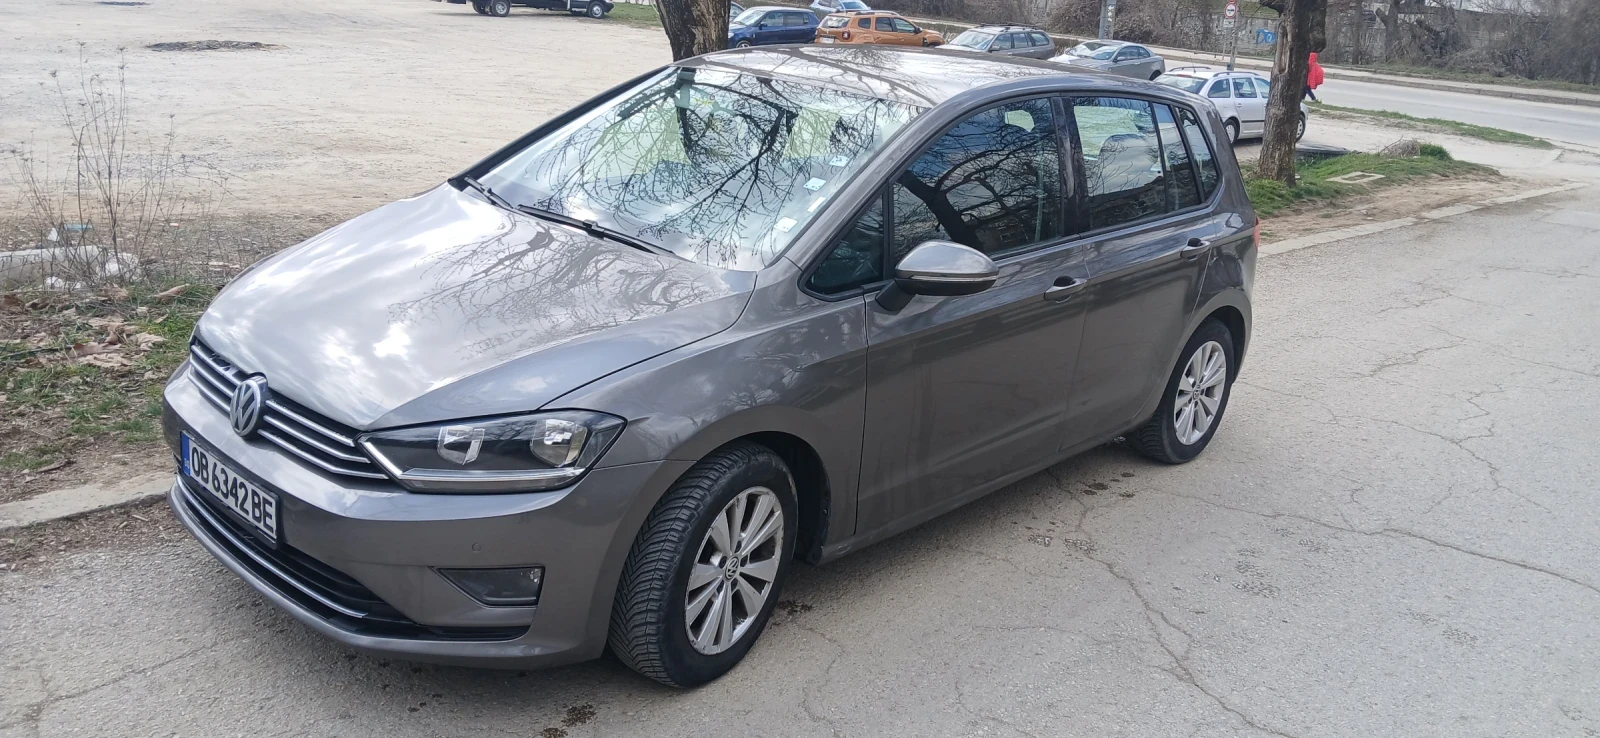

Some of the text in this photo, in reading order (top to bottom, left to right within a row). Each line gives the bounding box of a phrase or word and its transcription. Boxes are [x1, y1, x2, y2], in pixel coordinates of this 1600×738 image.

[192, 447, 274, 533] OB 6342 BE
